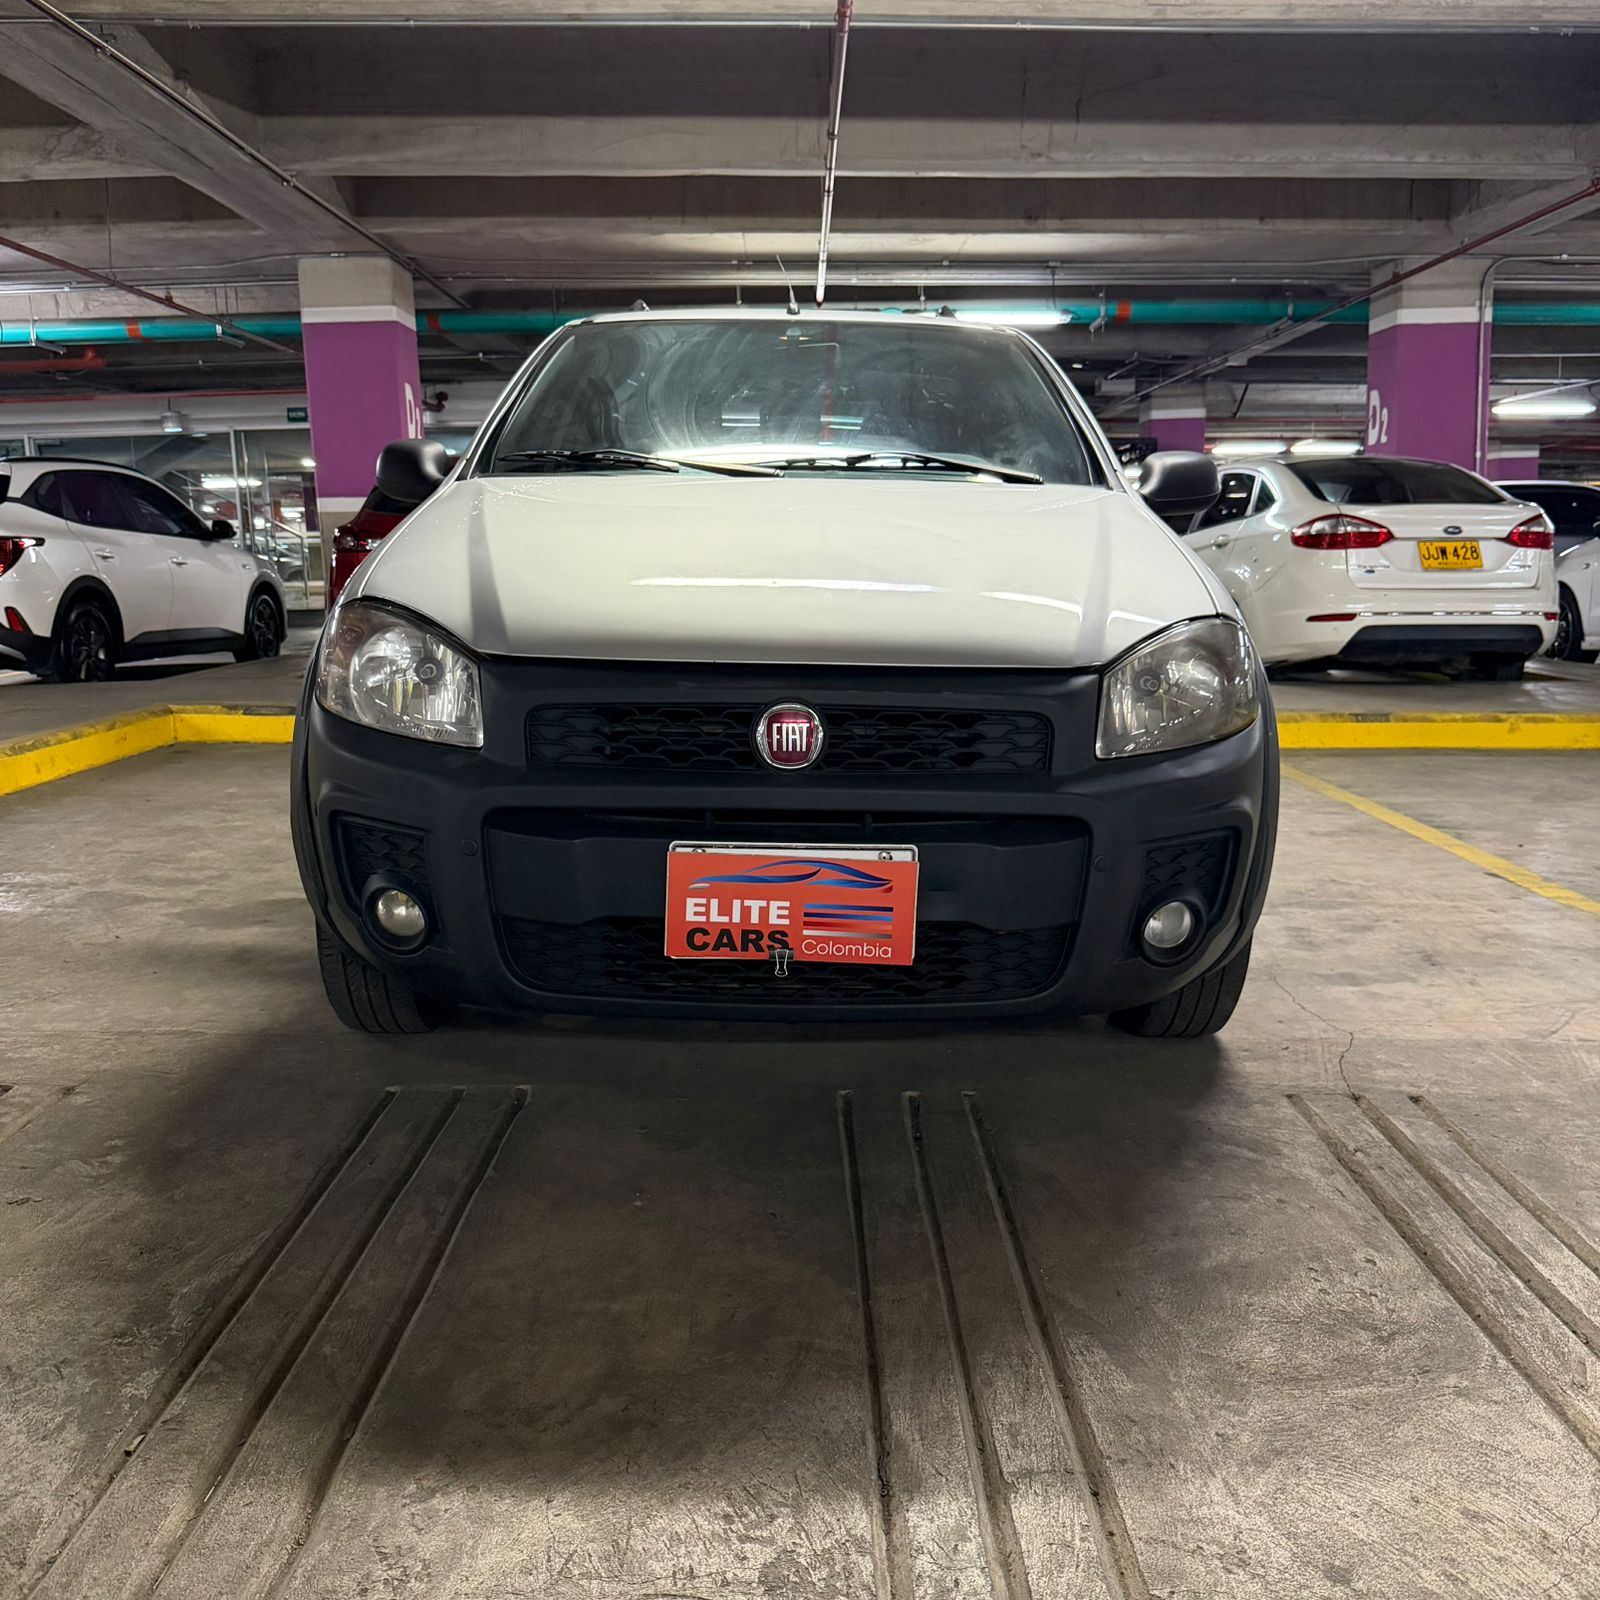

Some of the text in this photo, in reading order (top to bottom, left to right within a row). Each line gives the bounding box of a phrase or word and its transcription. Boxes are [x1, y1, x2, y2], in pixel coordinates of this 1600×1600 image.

[1367, 389, 1389, 446] D2
[1422, 545, 1480, 561] JJW 428
[772, 722, 810, 752] FIAT
[685, 897, 790, 925] ELITE
[686, 927, 791, 952] CARS
[802, 939, 892, 958] Colombia
